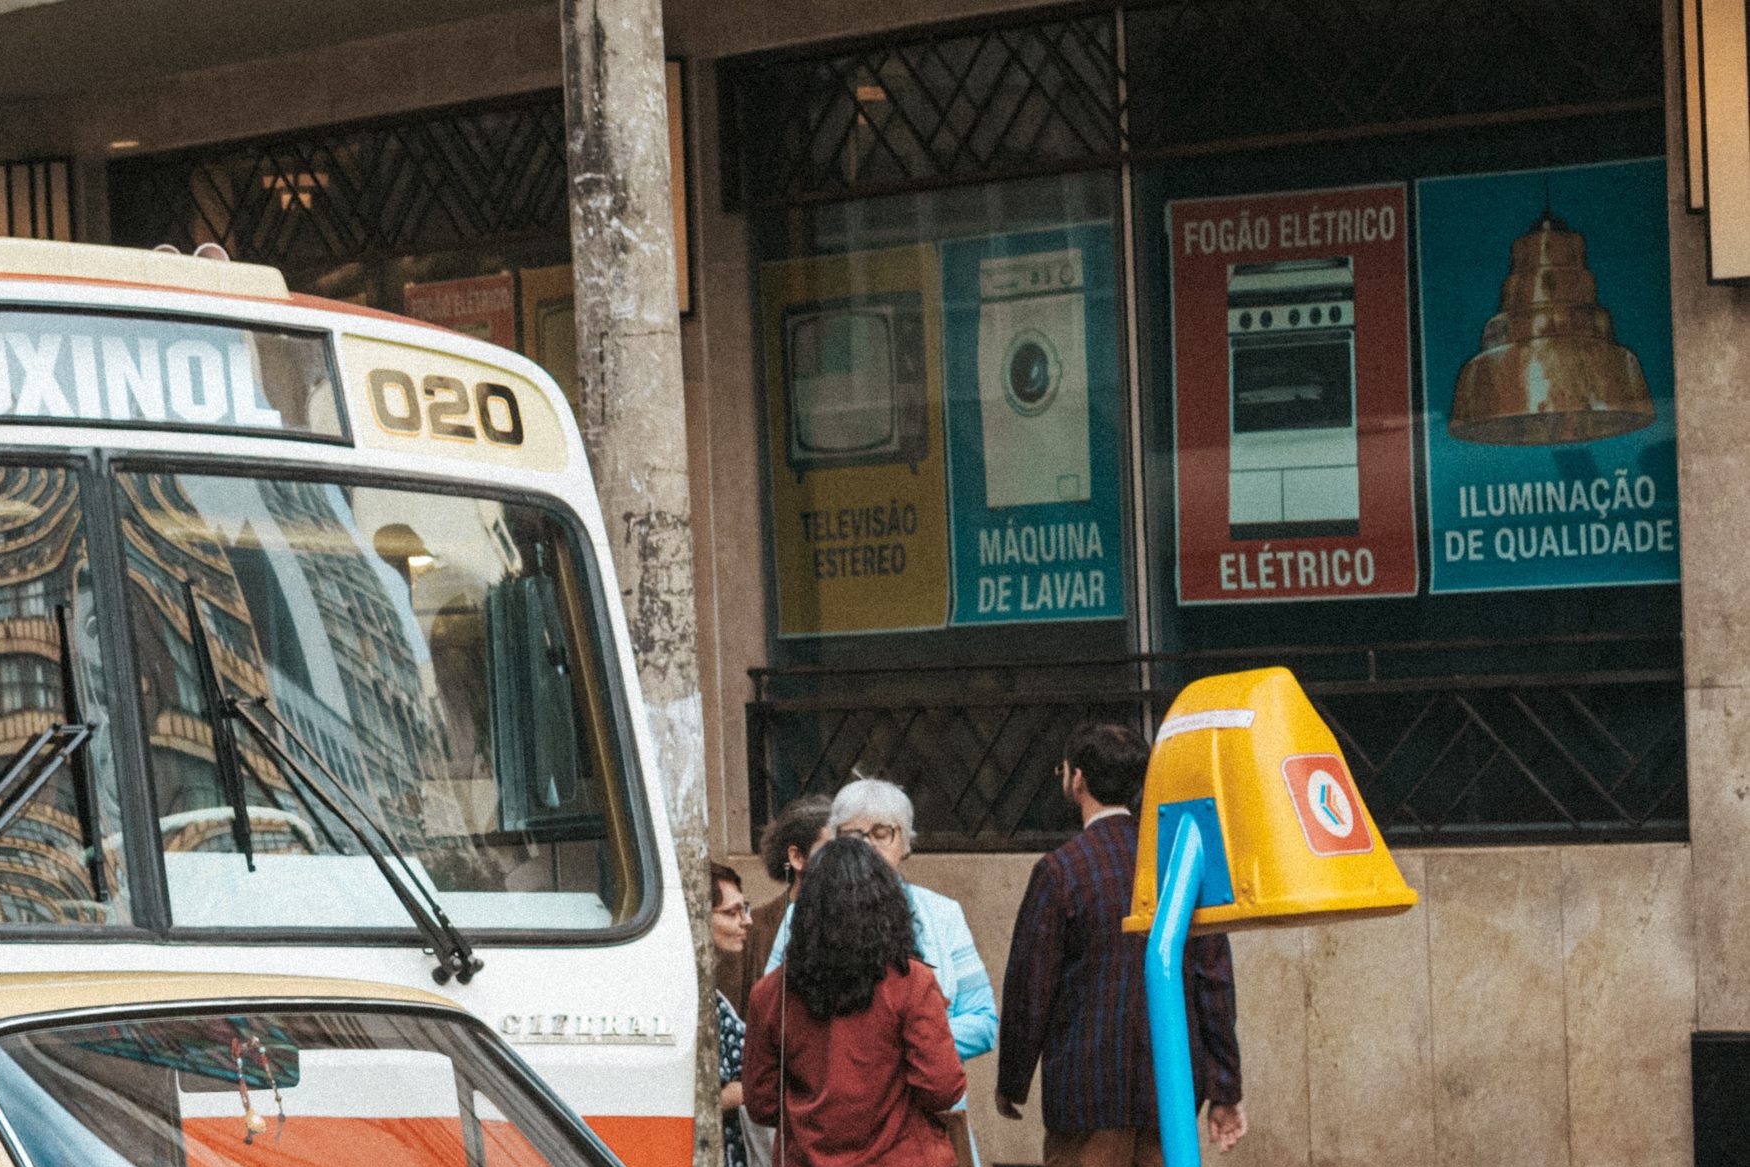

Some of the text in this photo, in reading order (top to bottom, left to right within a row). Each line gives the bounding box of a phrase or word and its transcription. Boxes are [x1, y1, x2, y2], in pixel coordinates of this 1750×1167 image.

[1184, 206, 1396, 255] FOGÃO ELÉTRICO
[366, 368, 524, 449] 020
[1459, 468, 1656, 519] ILUMINAÇÃO
[801, 499, 918, 542] TELEVISÃO
[978, 520, 1104, 566] MÁQUINA
[1445, 519, 1674, 562] DE QUALIDADE
[1220, 544, 1375, 590] ELÉTRICO
[977, 571, 1106, 613] DE LAVAR
